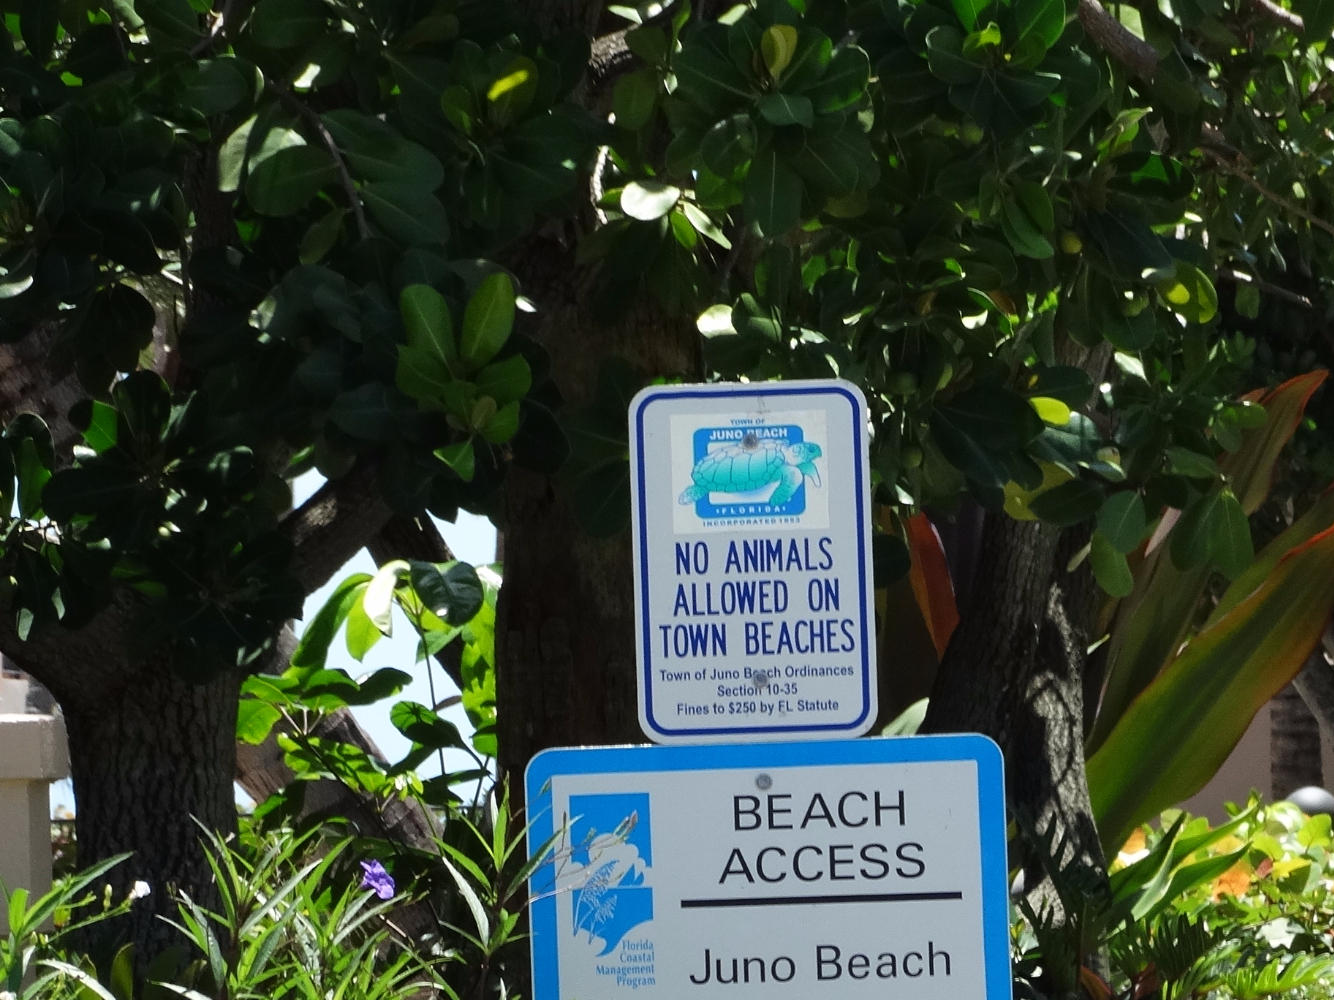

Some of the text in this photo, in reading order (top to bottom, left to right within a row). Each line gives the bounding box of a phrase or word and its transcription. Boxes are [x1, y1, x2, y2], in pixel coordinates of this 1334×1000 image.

[709, 429, 743, 440] JUNO
[703, 517, 776, 528] INCORPORATED
[675, 537, 834, 575] NO ANIMALS
[673, 577, 840, 617] ALLOWED ON
[659, 618, 856, 659] TOWN BEACHES
[660, 669, 691, 682] Town
[694, 668, 707, 681] of
[710, 667, 740, 681] Juno
[784, 664, 854, 679] Ordinances
[716, 682, 798, 698] Section 10-35
[677, 699, 840, 716] Fines to $250 by FL Statute
[732, 789, 907, 832] BEACH
[718, 841, 926, 885] ACCESS
[622, 939, 654, 951] Florida
[619, 951, 655, 963] Coastal
[689, 941, 952, 986] Juno Beach
[595, 963, 655, 976] Management
[616, 976, 656, 989] Program
